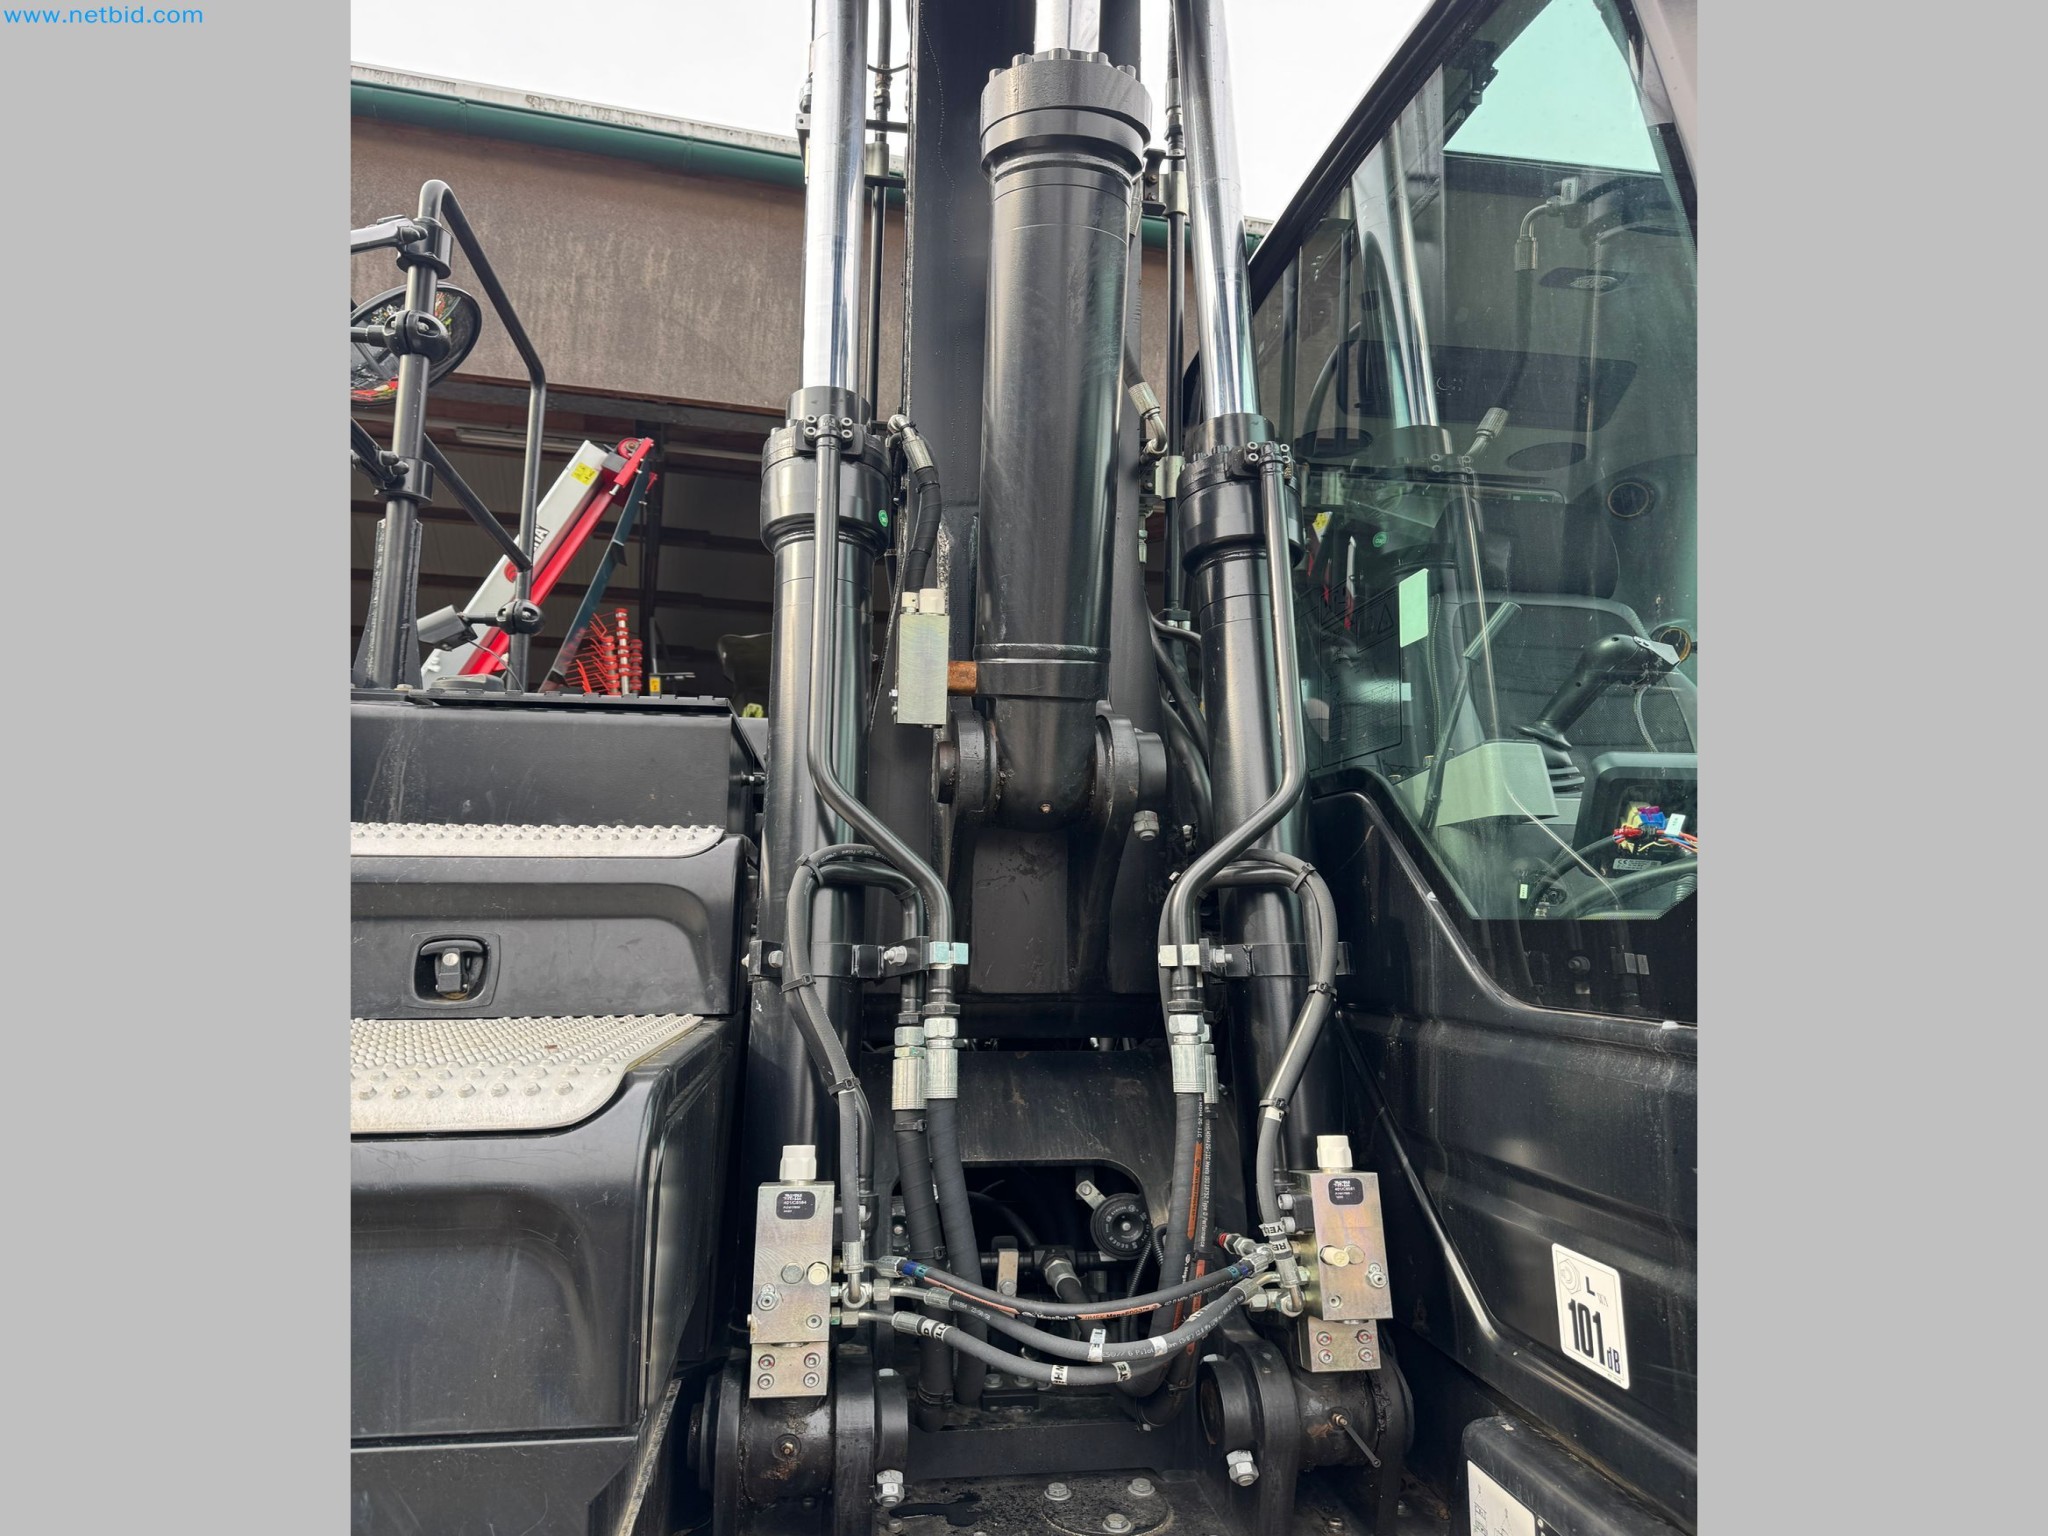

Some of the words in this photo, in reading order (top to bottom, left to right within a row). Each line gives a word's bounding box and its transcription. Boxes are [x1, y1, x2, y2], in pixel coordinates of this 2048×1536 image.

[1585, 1275, 1596, 1297] L
[1567, 1297, 1606, 1366] 101
[1606, 1346, 1621, 1375] dB
